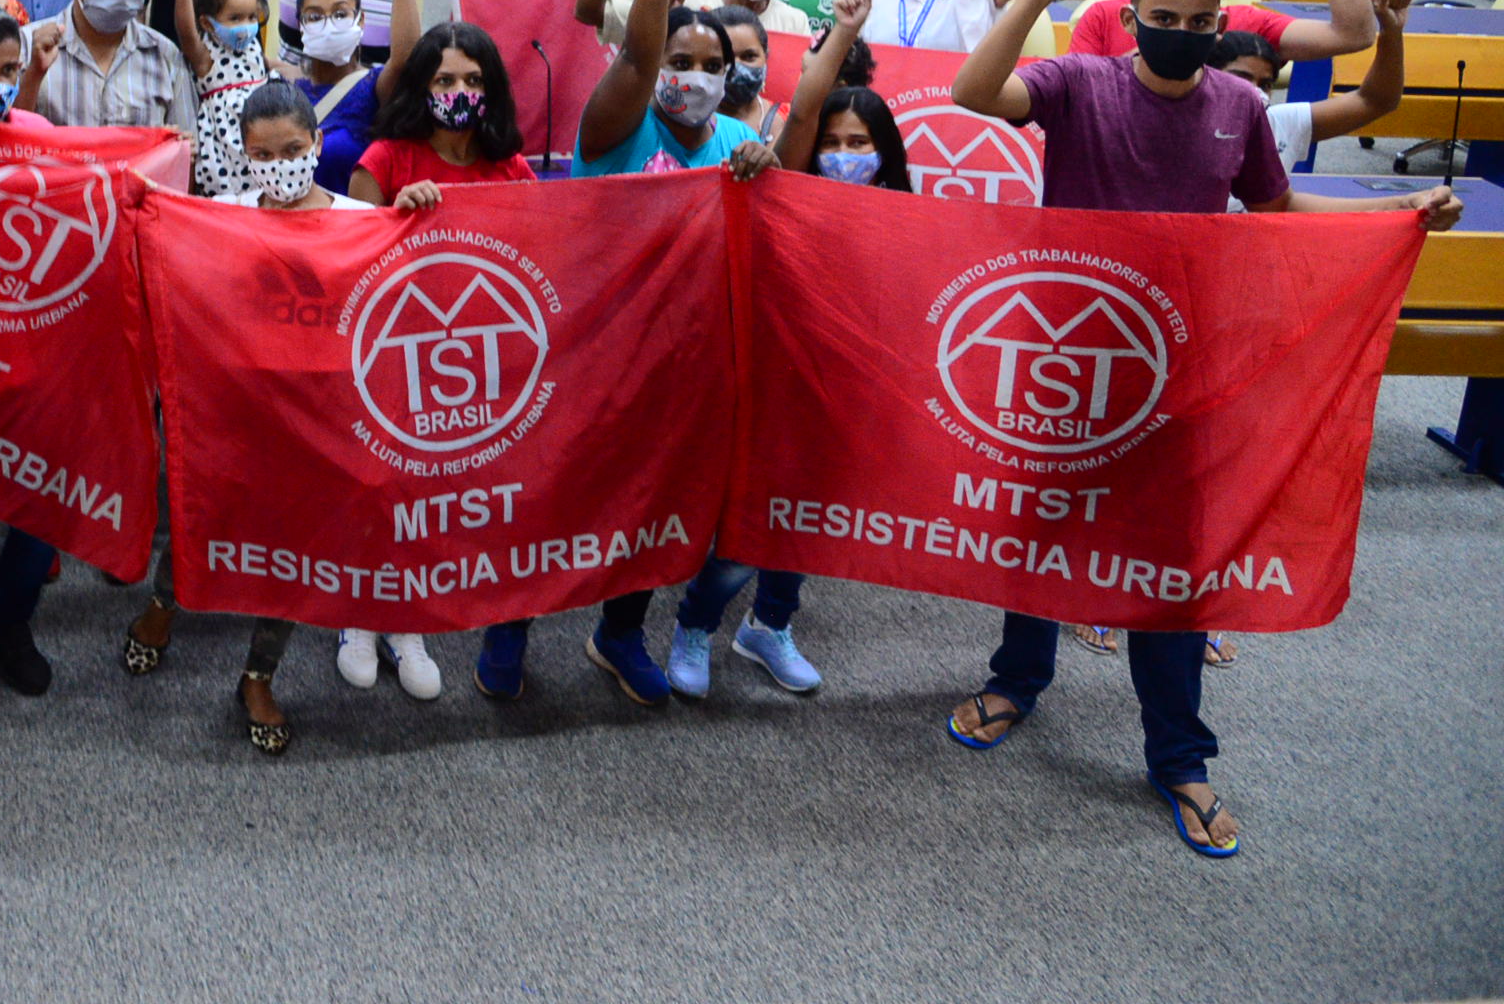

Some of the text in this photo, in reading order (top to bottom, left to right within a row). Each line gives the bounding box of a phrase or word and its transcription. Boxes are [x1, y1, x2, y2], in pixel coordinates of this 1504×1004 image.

[897, 88, 922, 105] DOS
[30, 291, 89, 329] URBANA
[336, 228, 562, 336] MOVIMENTO DOS TRABALHADORES SEM TETO
[925, 248, 1188, 344] MOVIMENTO DOS TRABALHADORES SEM TETO
[351, 381, 556, 476] NA LUTA PELA REFORMA URBANA
[414, 404, 498, 436] BRASIL
[924, 397, 944, 420] NA
[939, 416, 975, 450] LUTA
[975, 444, 1019, 468] PELA
[1024, 455, 1110, 473] REFORMA
[997, 410, 1098, 440] BRASIL
[394, 483, 522, 543] MTST
[952, 473, 1111, 522] MTST
[206, 513, 690, 602] RESISTÊNCIA URBANA
[768, 497, 1293, 602] RESISTÊNCIA URBANA
